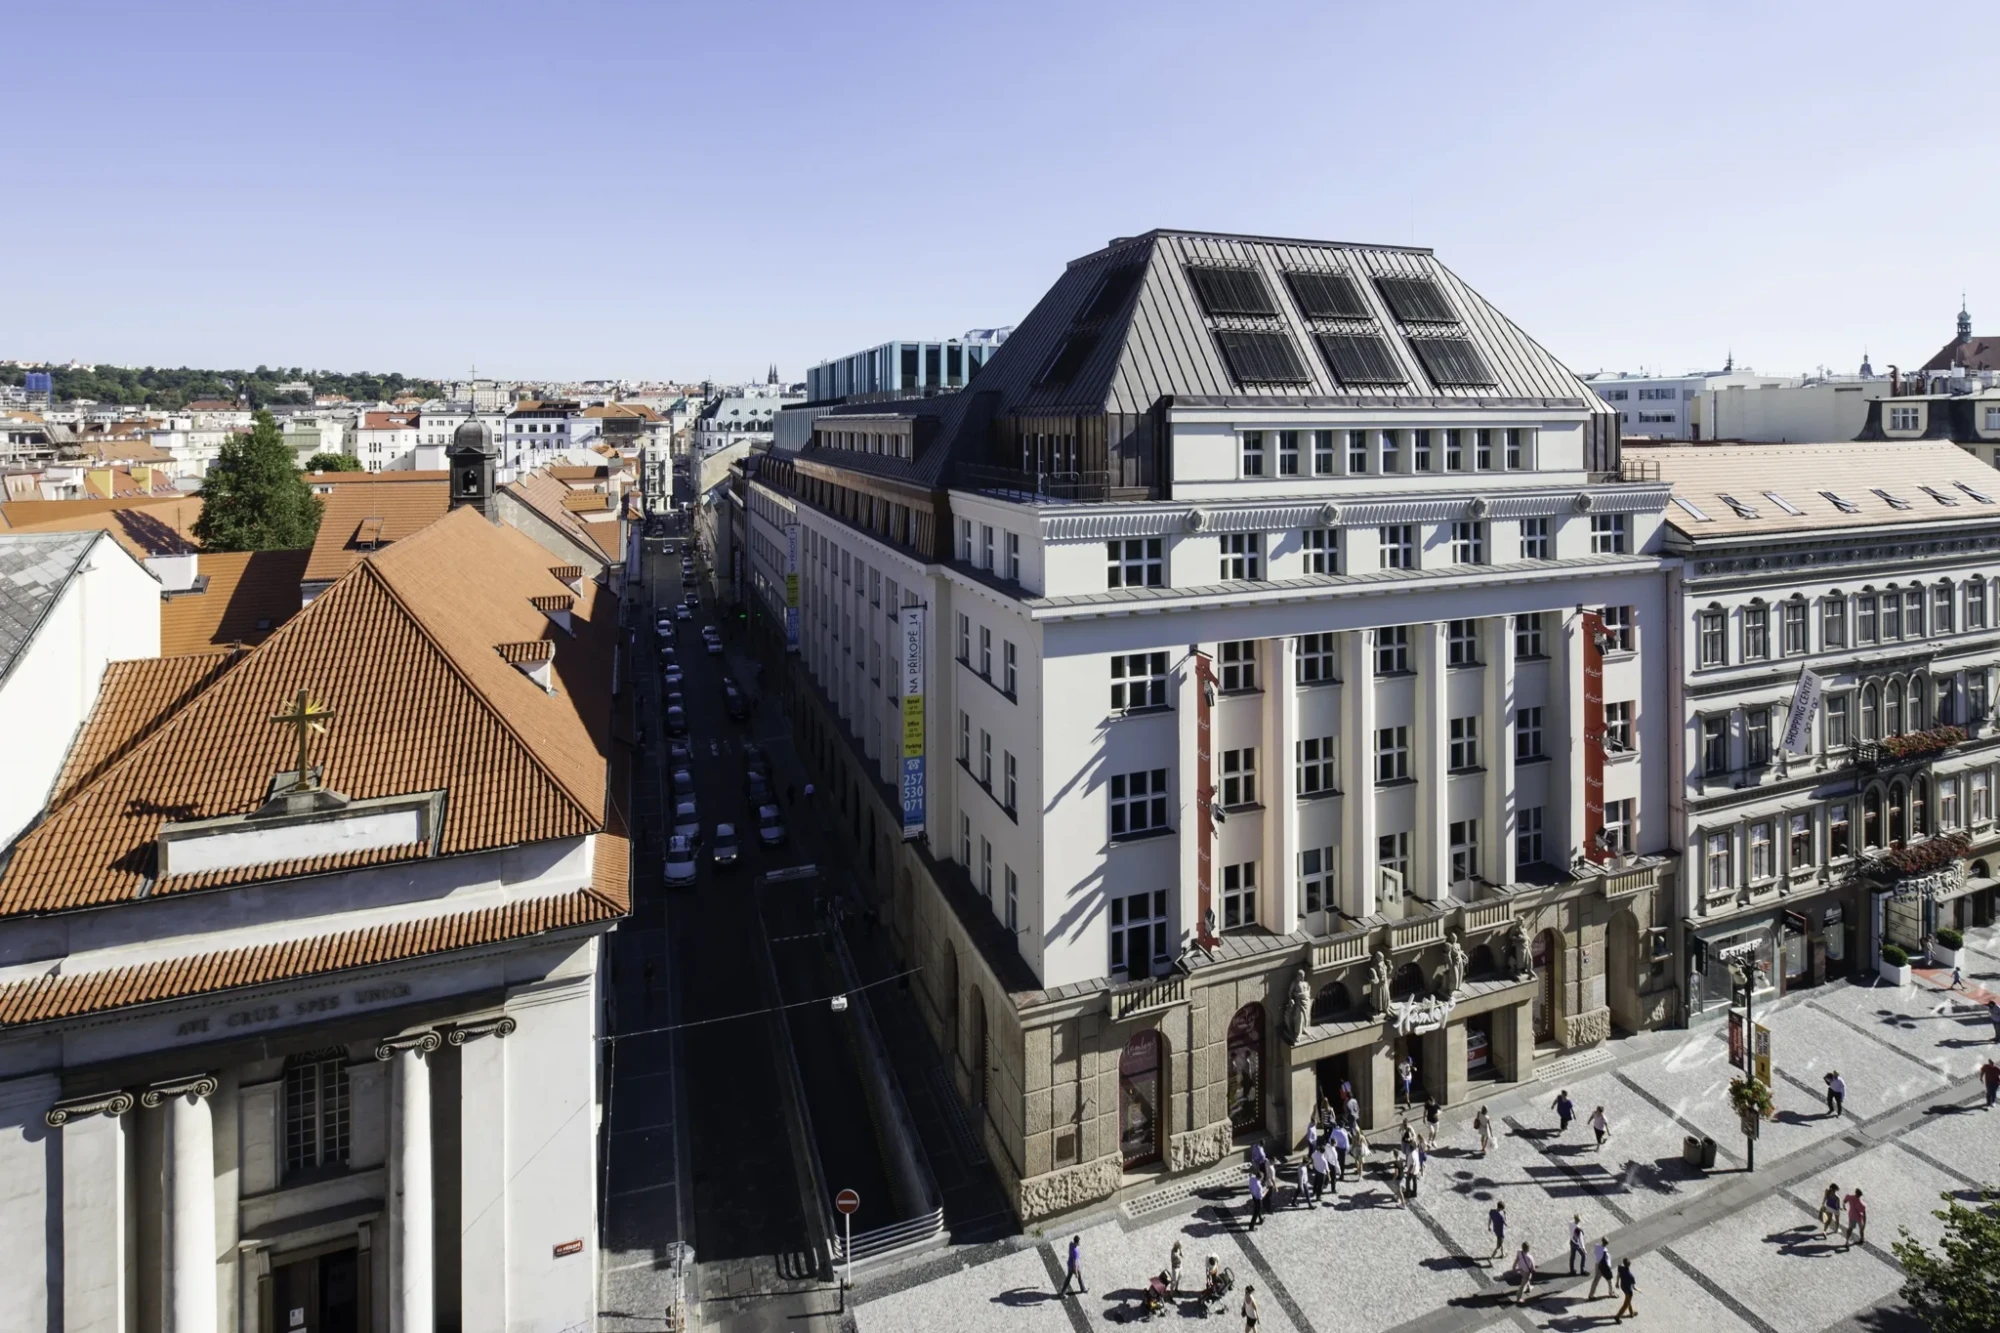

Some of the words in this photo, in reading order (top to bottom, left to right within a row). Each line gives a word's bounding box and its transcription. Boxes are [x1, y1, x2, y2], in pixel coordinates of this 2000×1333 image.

[909, 613, 918, 625] 14
[907, 630, 919, 674] PŘÍKOPĚ
[909, 677, 918, 694] NA
[1785, 704, 1806, 746] SHOPPING
[1798, 675, 1814, 705] CENTER
[904, 772, 923, 786] 257
[904, 785, 924, 799] 530
[904, 798, 923, 812] 071
[176, 1017, 210, 1037] AVE
[226, 1004, 281, 1028] CRUX
[294, 995, 340, 1016] SPES
[354, 983, 412, 1004] UNICA
[1393, 993, 1456, 1037] Hamleys
